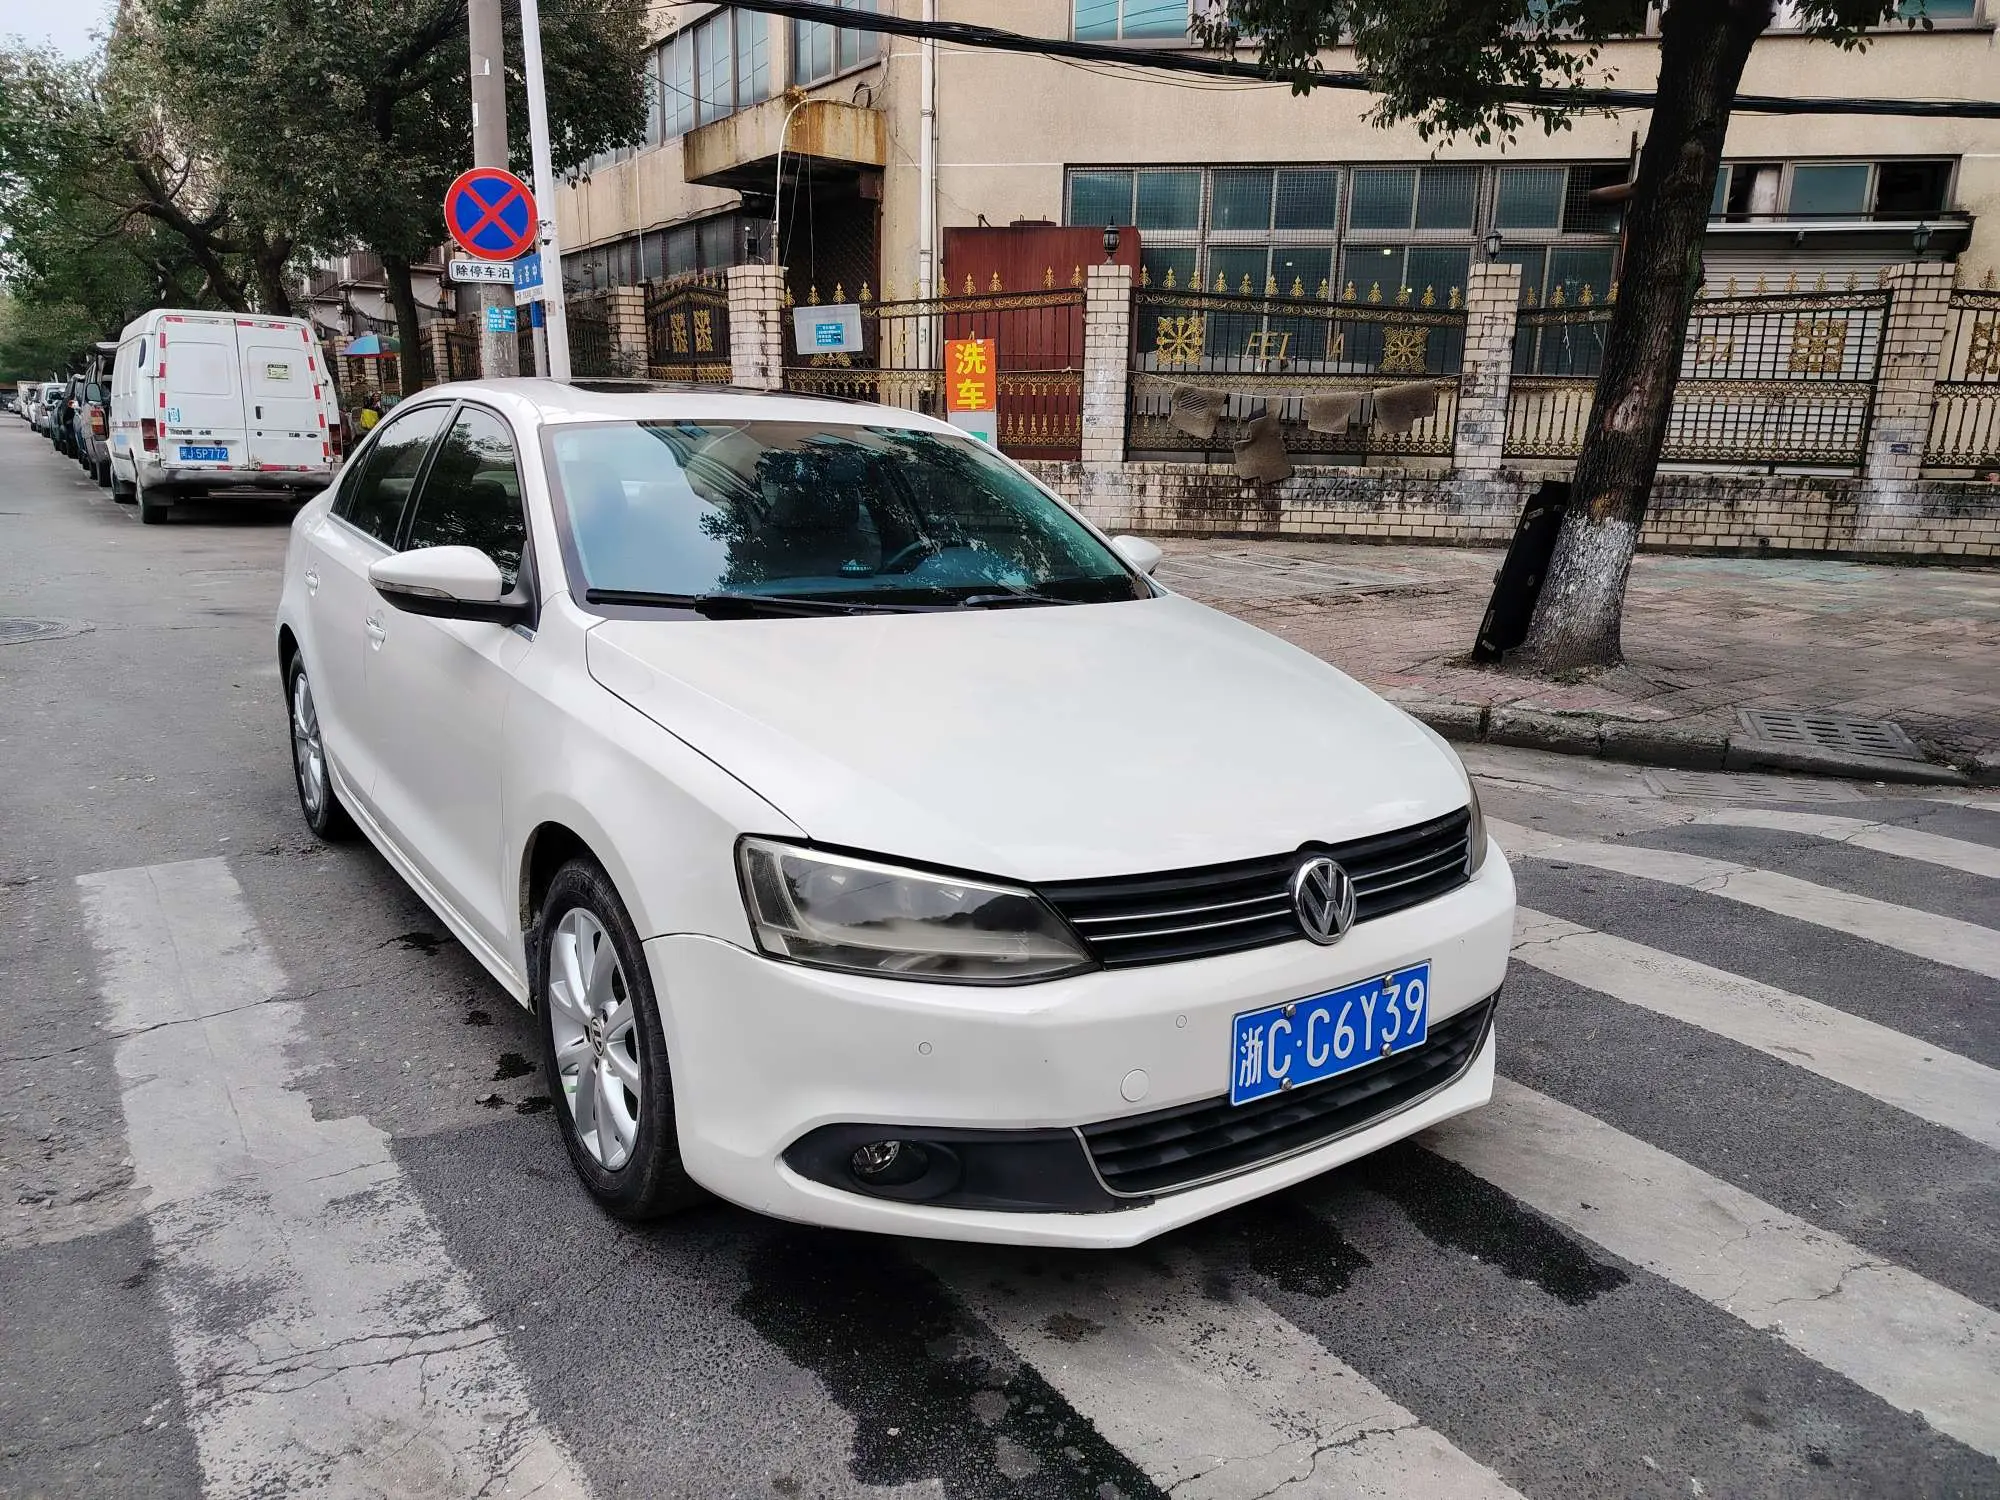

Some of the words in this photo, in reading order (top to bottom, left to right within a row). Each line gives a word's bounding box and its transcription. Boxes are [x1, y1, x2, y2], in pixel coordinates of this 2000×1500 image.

[456, 264, 514, 279] 除停车泊
[955, 342, 987, 410] 洗车
